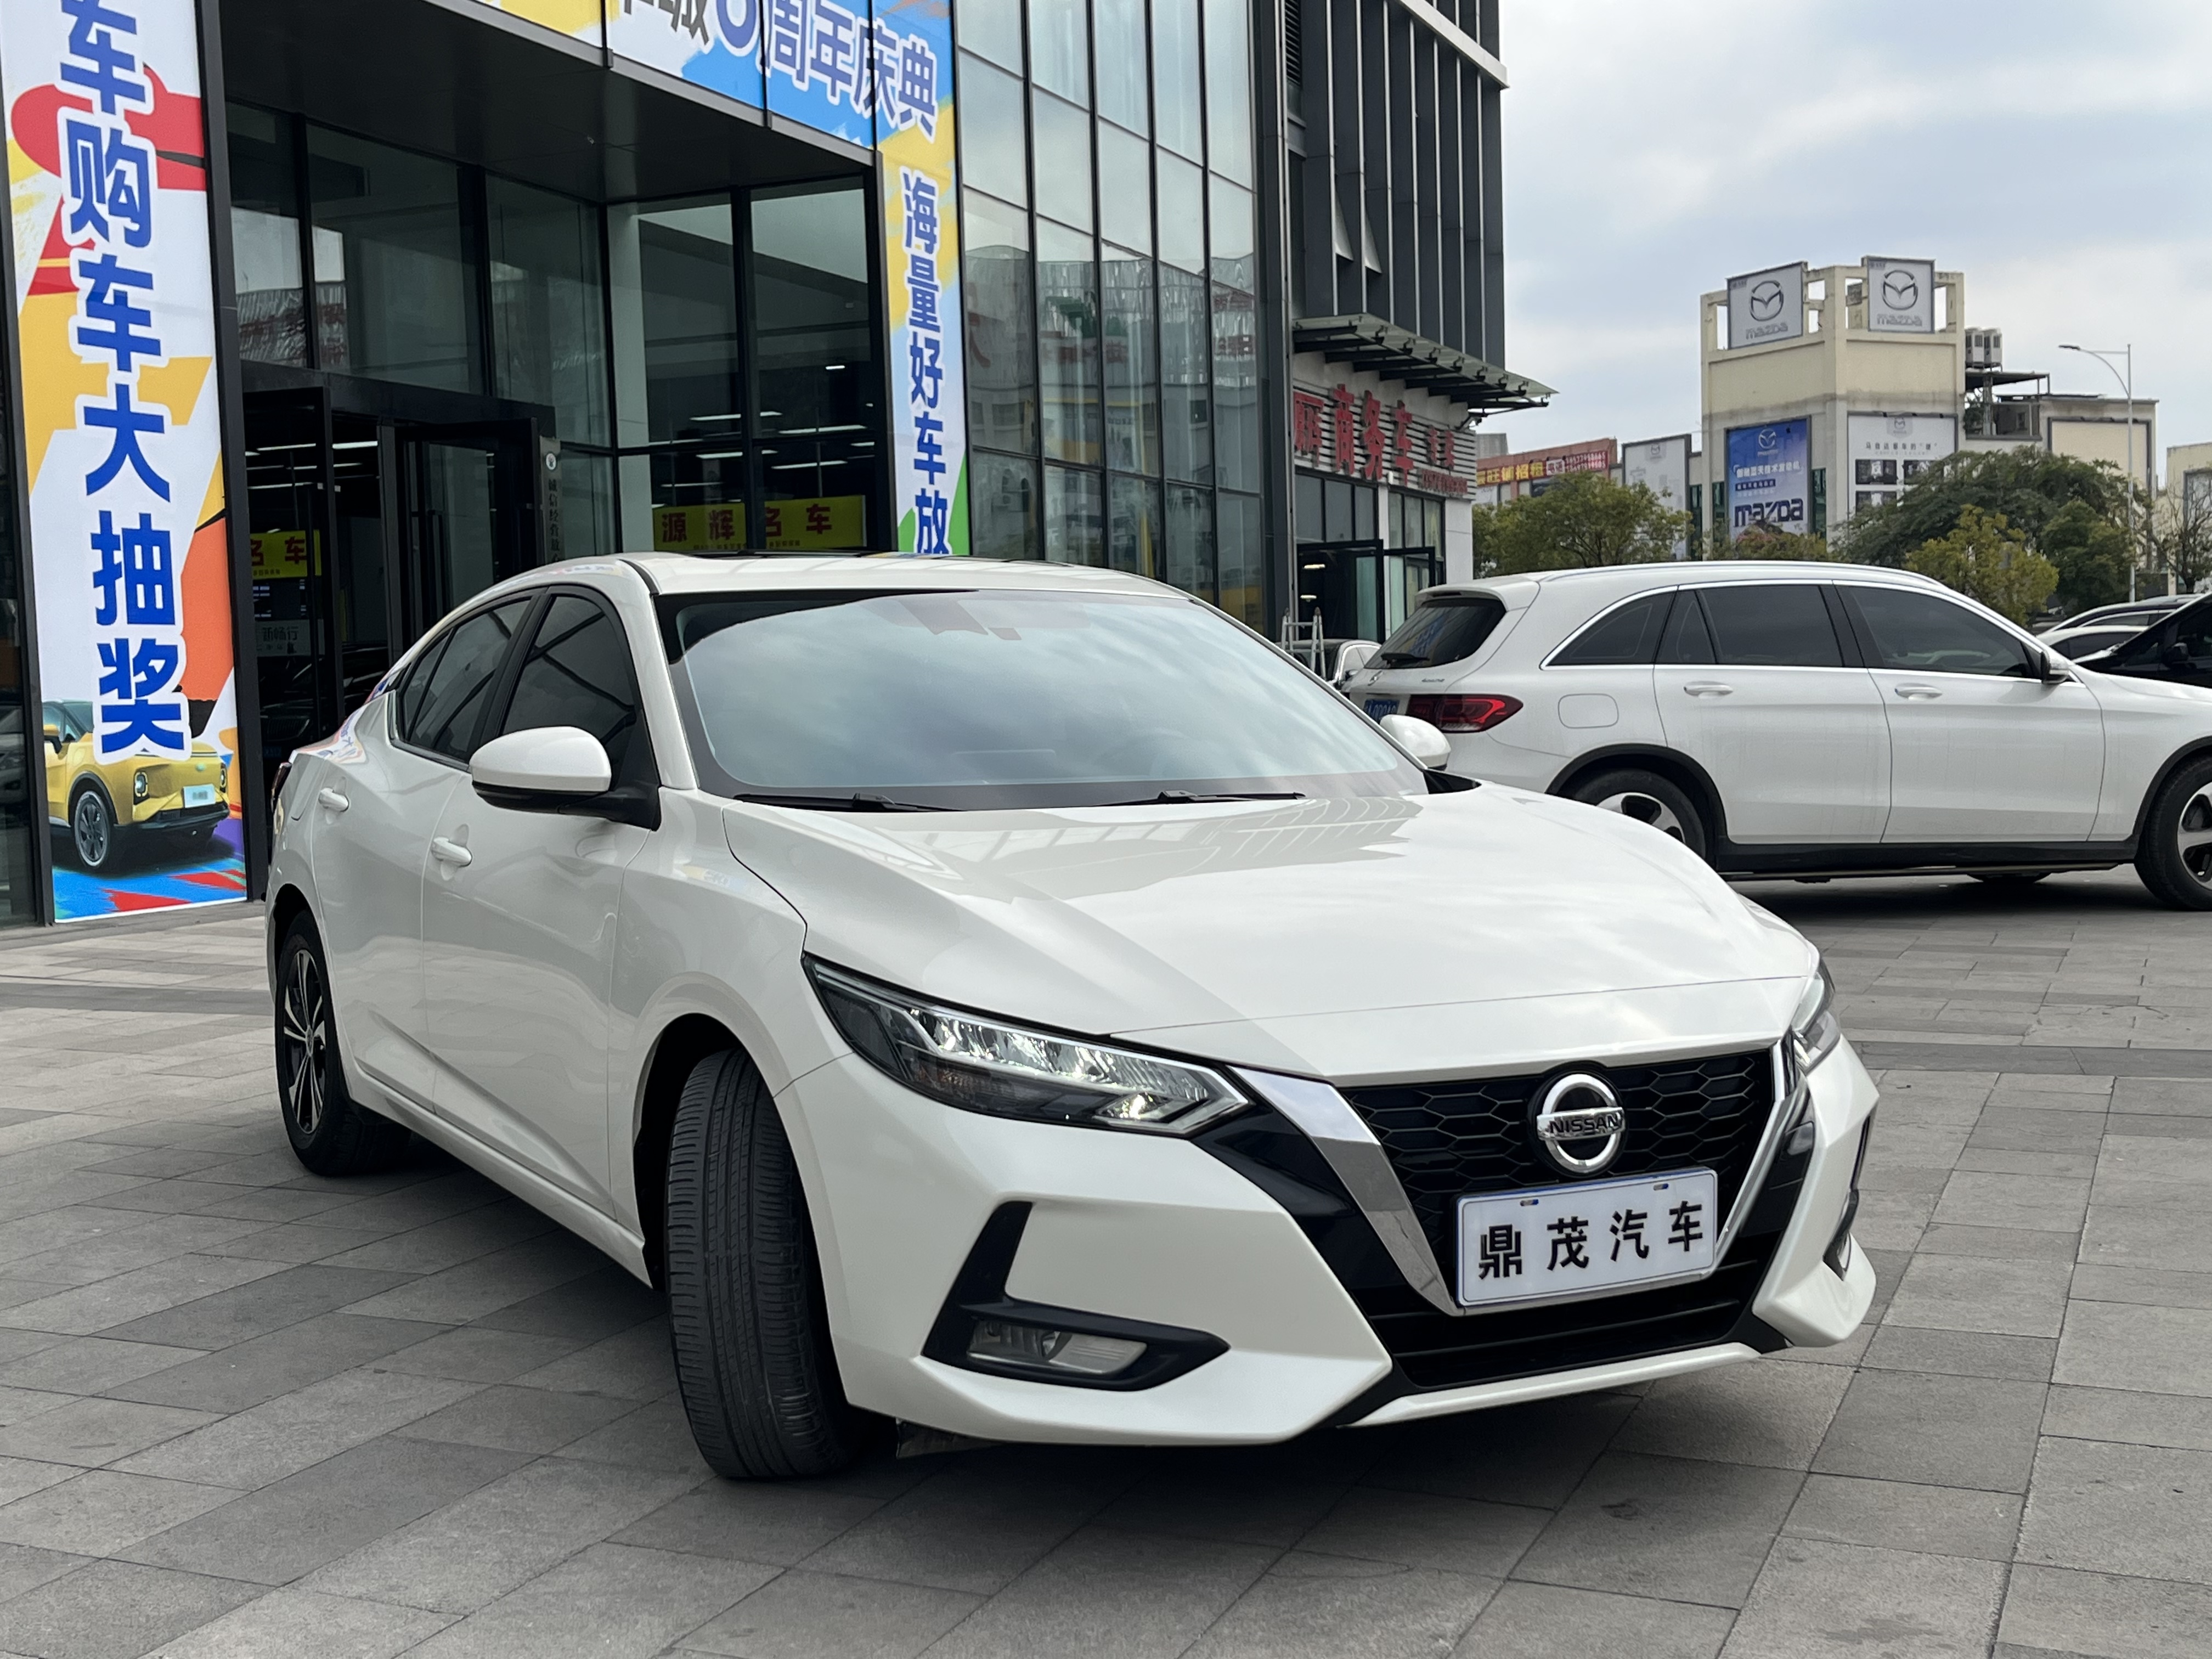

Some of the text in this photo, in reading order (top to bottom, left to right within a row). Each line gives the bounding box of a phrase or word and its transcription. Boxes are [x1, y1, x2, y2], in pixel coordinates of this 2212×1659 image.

[61, 0, 184, 754] 车购车大抽奖
[903, 173, 949, 554] 海量好车放
[1735, 498, 1804, 527] mazda
[1549, 1113, 1620, 1133] NISSAN
[1479, 1200, 1703, 1280] 鼎茂汽车
